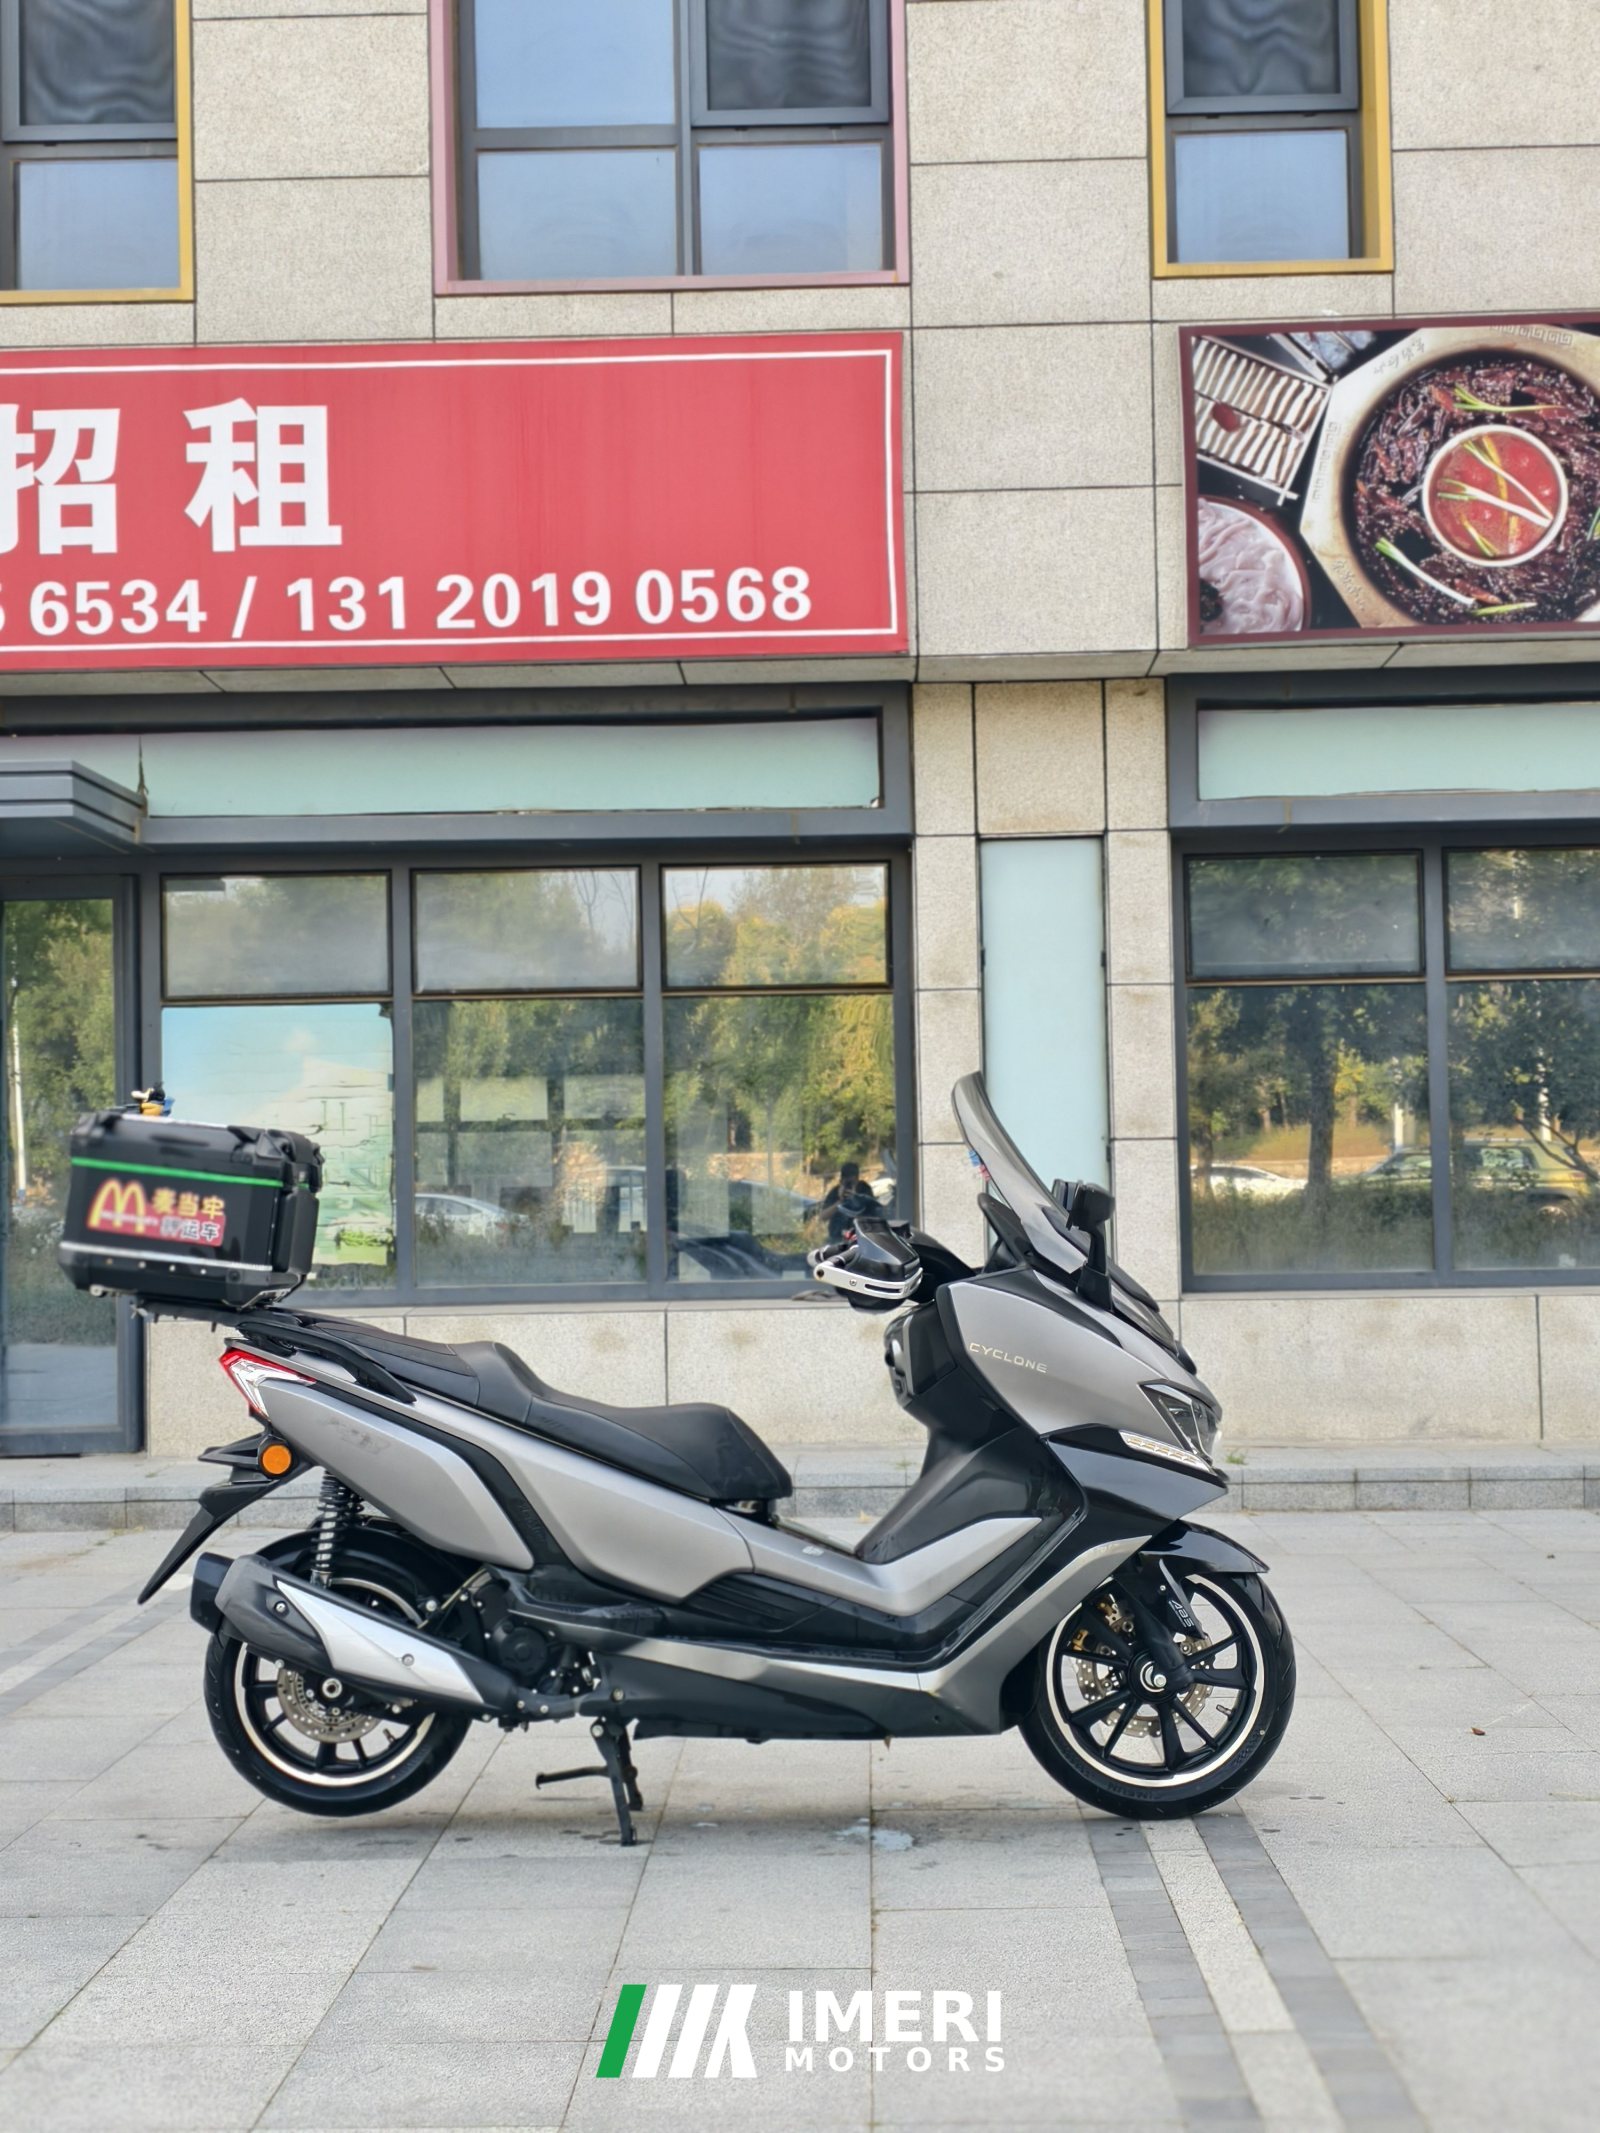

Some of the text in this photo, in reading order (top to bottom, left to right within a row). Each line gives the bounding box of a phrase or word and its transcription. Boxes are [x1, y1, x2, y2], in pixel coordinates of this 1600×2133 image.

[30, 579, 207, 636] 6534
[287, 576, 406, 631] 131
[437, 571, 611, 629] 2019
[635, 567, 812, 625] 0568
[969, 1342, 1048, 1374] CYCLONE
